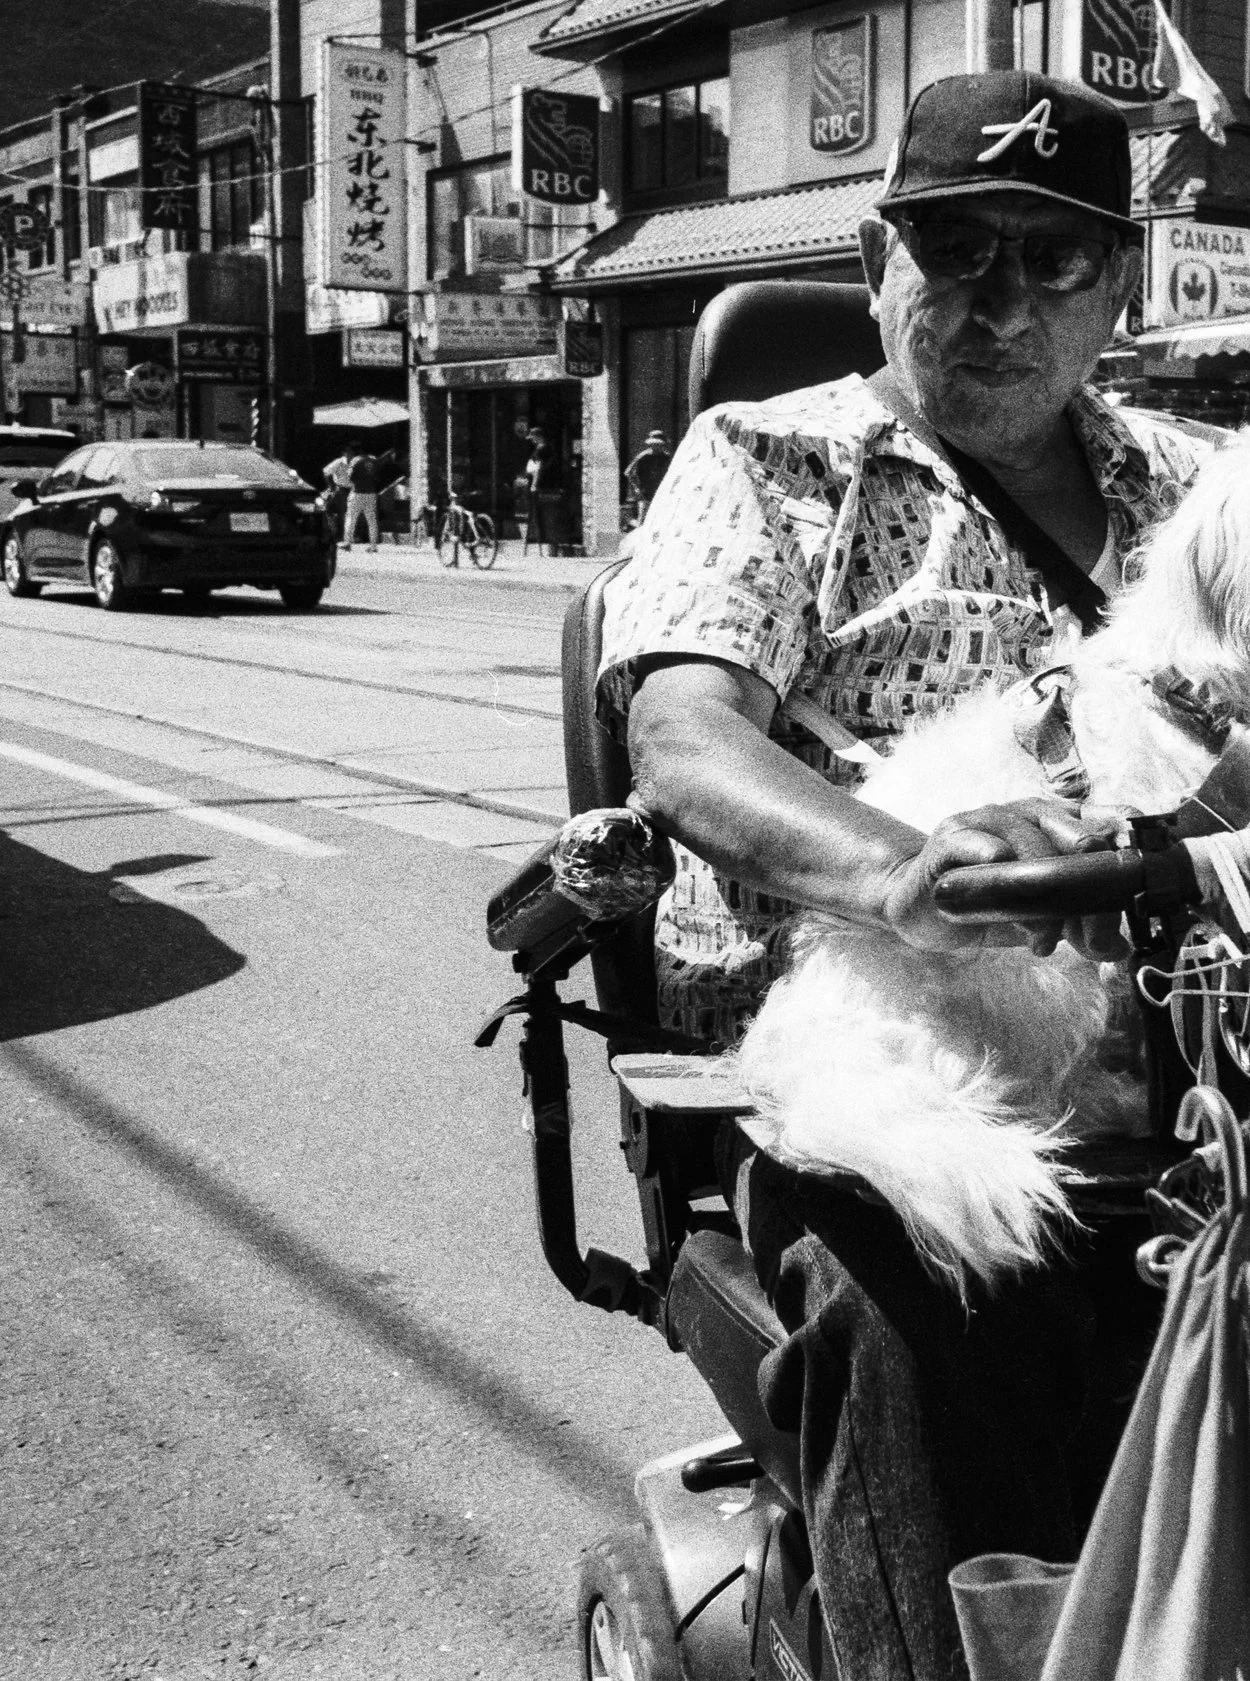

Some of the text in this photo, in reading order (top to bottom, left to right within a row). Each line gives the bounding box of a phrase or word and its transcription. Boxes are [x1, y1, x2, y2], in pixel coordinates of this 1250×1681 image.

[1092, 51, 1162, 94] RBC
[813, 111, 861, 144] RBC
[977, 98, 1058, 162] A
[531, 168, 592, 198] RBC
[1170, 228, 1245, 256] CANADA
